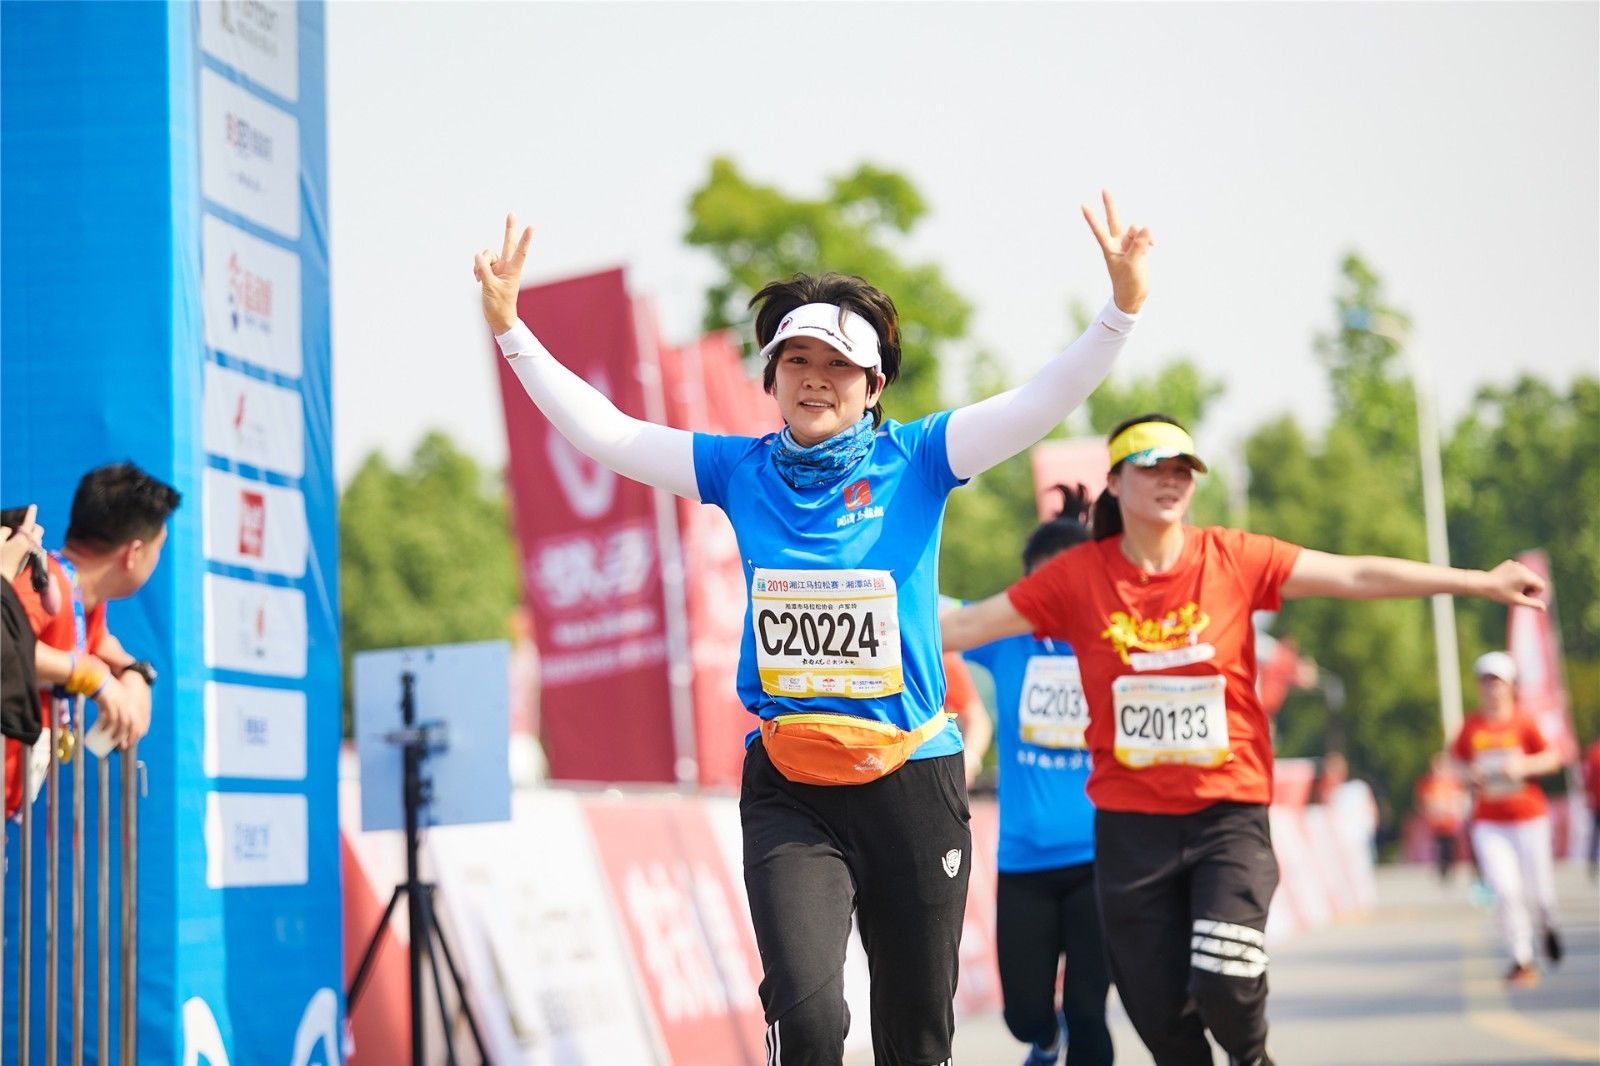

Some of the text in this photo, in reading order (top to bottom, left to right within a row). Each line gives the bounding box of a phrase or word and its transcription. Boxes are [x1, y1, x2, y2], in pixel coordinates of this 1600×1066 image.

[758, 609, 879, 658] C20224
[1028, 683, 1088, 718] C203
[1121, 705, 1209, 741] C20133
